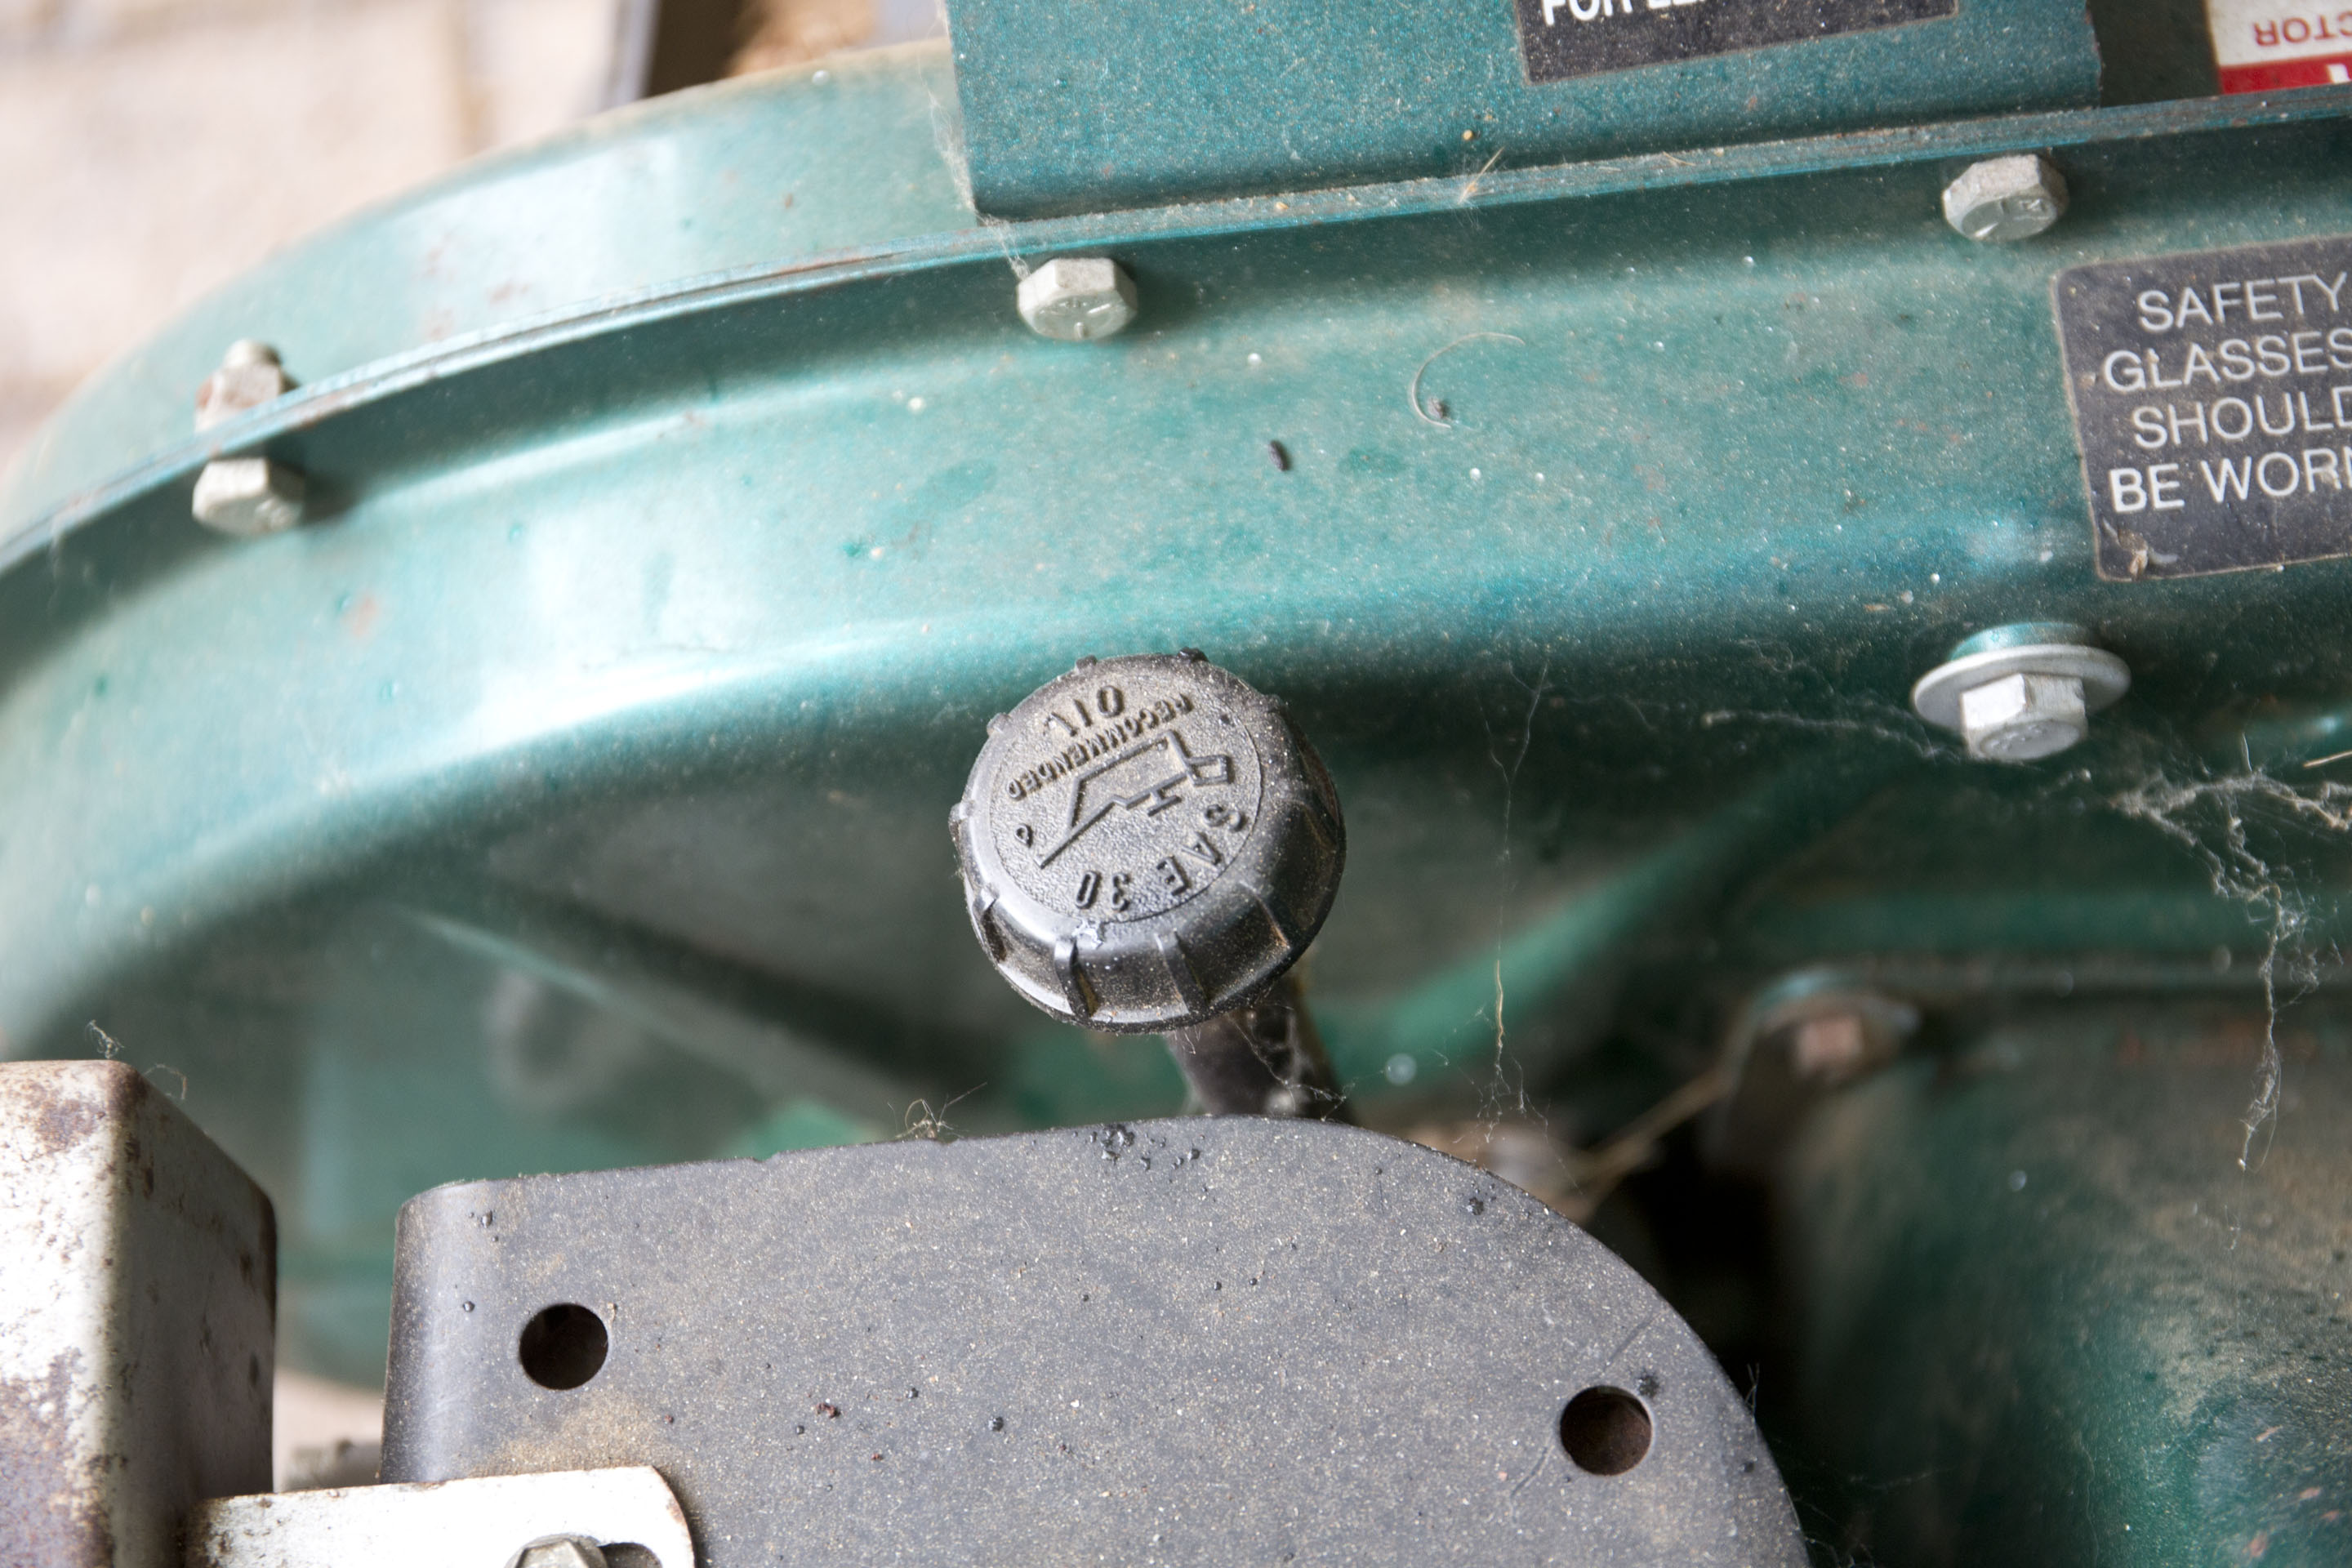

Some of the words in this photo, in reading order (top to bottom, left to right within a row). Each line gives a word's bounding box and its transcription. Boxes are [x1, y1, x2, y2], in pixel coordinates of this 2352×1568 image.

[2137, 271, 2347, 331] SAFETY
[2104, 327, 2352, 392] GLASSES
[2108, 463, 2185, 512] BE
[1044, 684, 1125, 738] OIL
[1004, 692, 1194, 801] RECOMMENDED
[1156, 802, 1249, 897] SAE
[1074, 870, 1132, 911] 30
